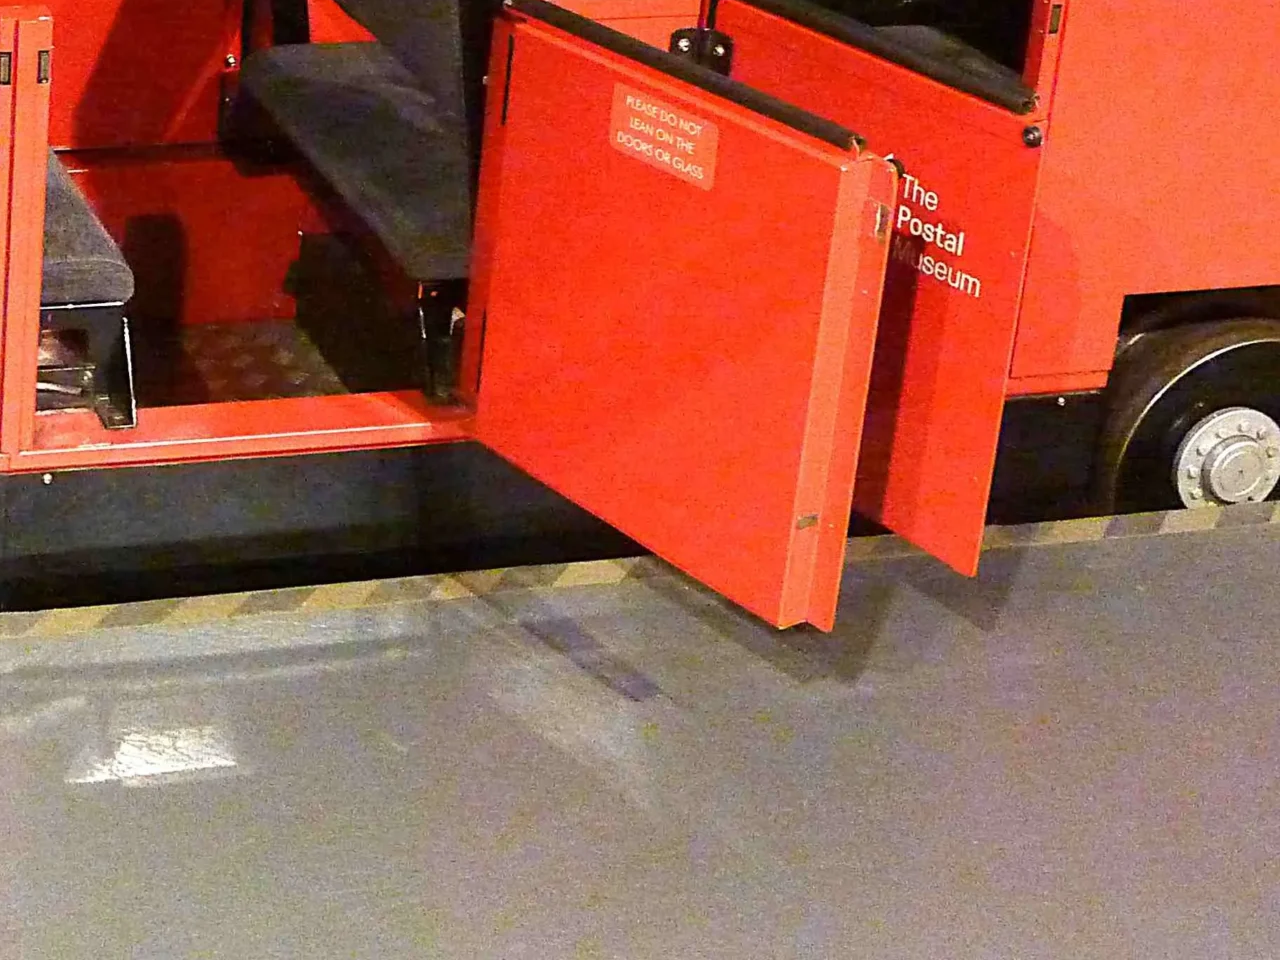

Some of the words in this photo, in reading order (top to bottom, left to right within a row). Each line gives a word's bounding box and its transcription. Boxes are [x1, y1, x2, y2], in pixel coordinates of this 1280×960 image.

[625, 94, 659, 119] PLEASE
[660, 108, 677, 127] DO
[679, 118, 702, 137] NOT
[629, 116, 654, 137] LEAN
[656, 127, 674, 145] ON
[675, 136, 697, 156] THE
[617, 130, 653, 157] DOORS
[654, 148, 671, 165] OR
[672, 156, 704, 180] GLASS
[902, 173, 938, 211] The
[896, 204, 965, 256] Postal
